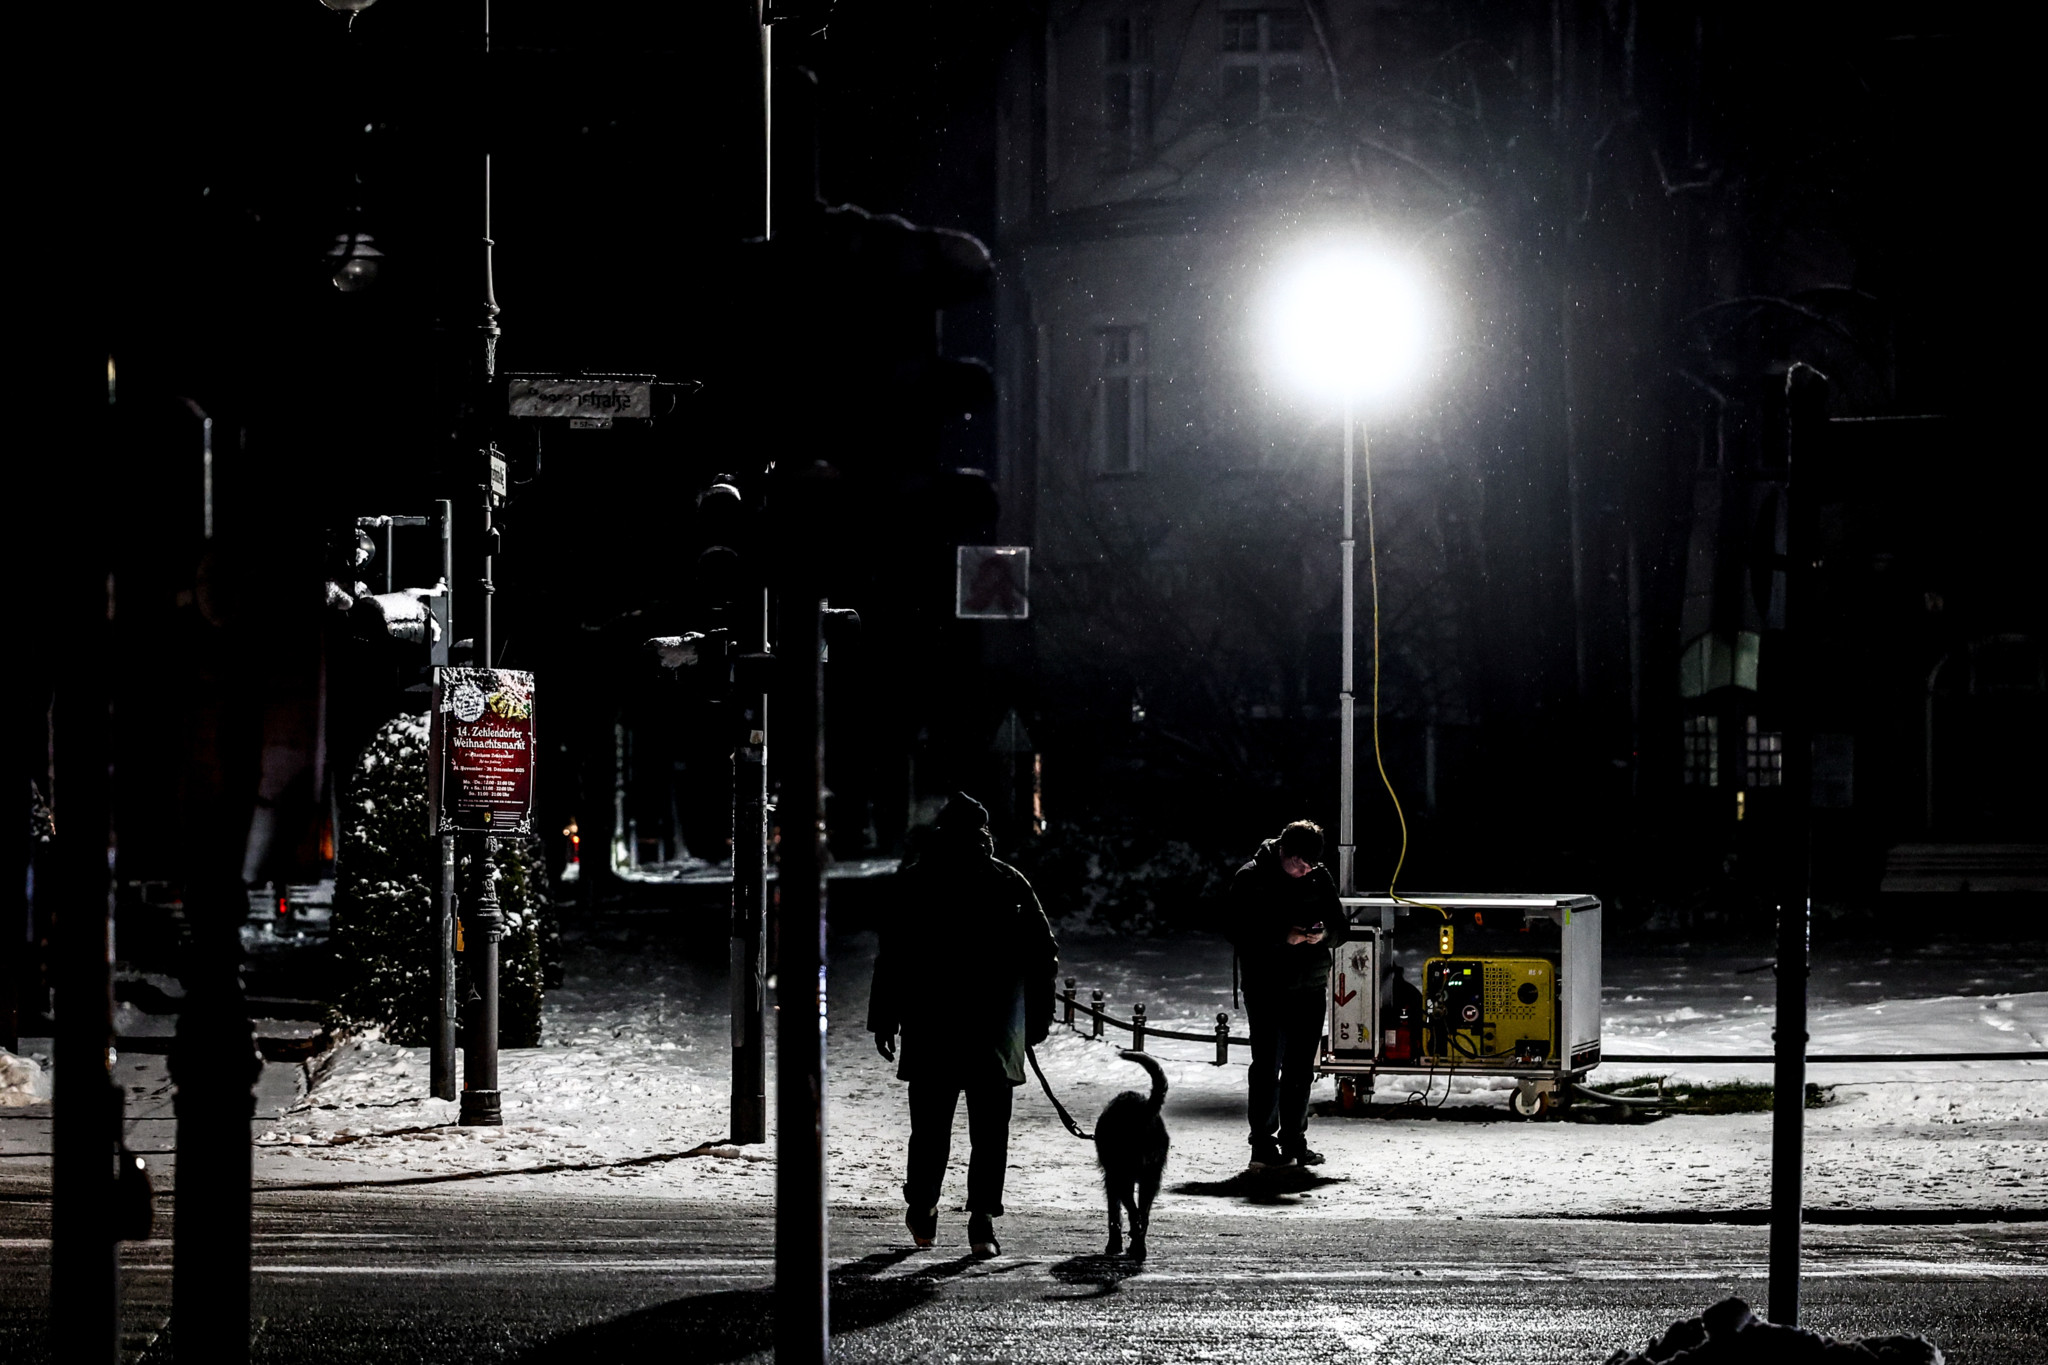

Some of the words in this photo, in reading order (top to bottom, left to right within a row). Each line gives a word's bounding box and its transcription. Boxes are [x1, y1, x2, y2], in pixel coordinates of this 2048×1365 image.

[456, 726, 470, 736] 14.
[471, 726, 523, 738] Zehlendorfer
[452, 737, 526, 750] Weihnachtsmarkt
[1341, 1022, 1349, 1040] 2.0
